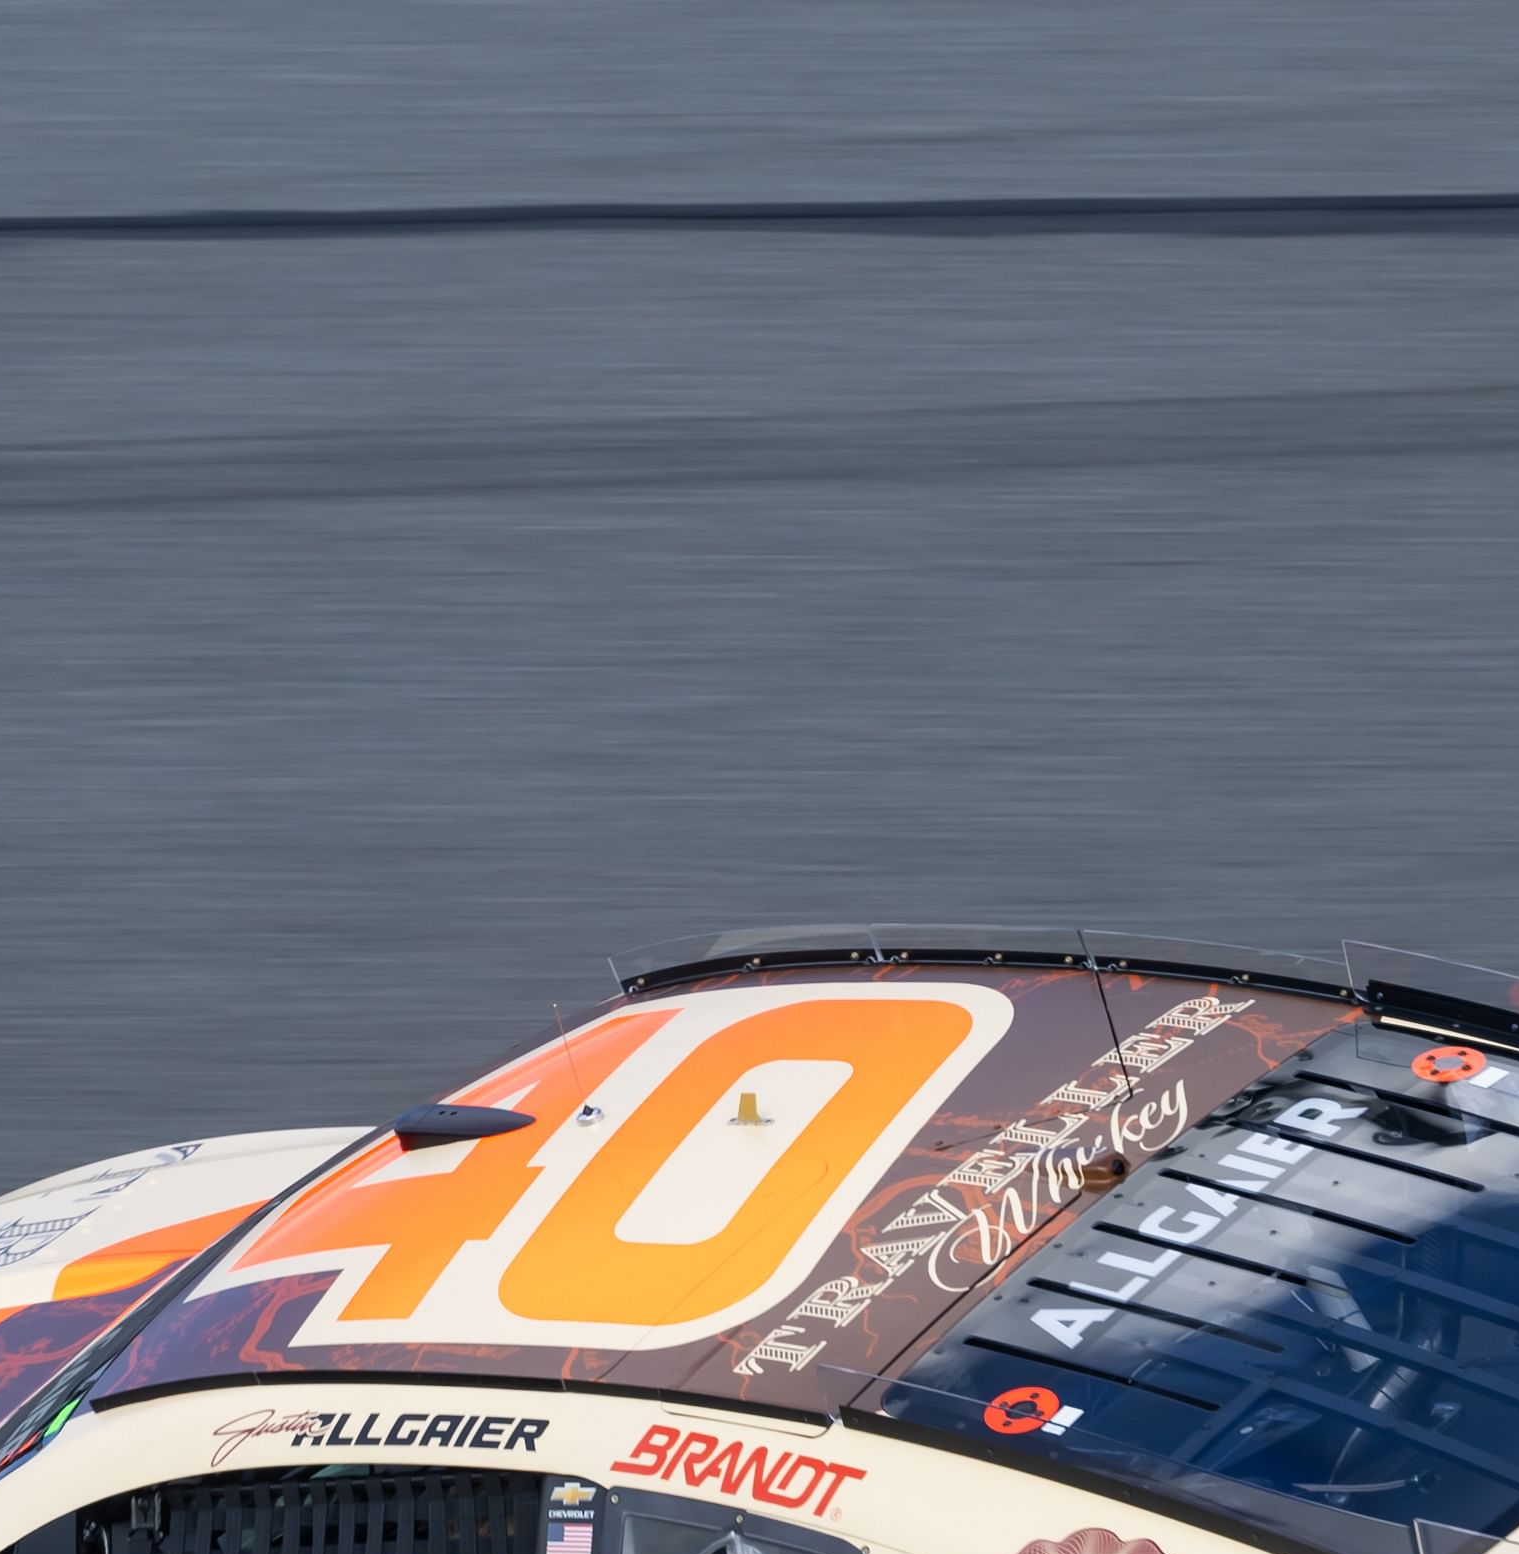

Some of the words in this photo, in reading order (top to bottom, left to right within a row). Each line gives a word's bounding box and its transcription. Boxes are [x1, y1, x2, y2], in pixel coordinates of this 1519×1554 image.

[228, 999, 974, 1327] 40
[732, 996, 1256, 1375] TRAVELLER
[1029, 1095, 1368, 1349] ALLGAIER
[291, 1412, 551, 1453] ALLGAIER
[548, 1509, 595, 1520] CHEVROLET
[610, 1423, 869, 1520] BRANDT
